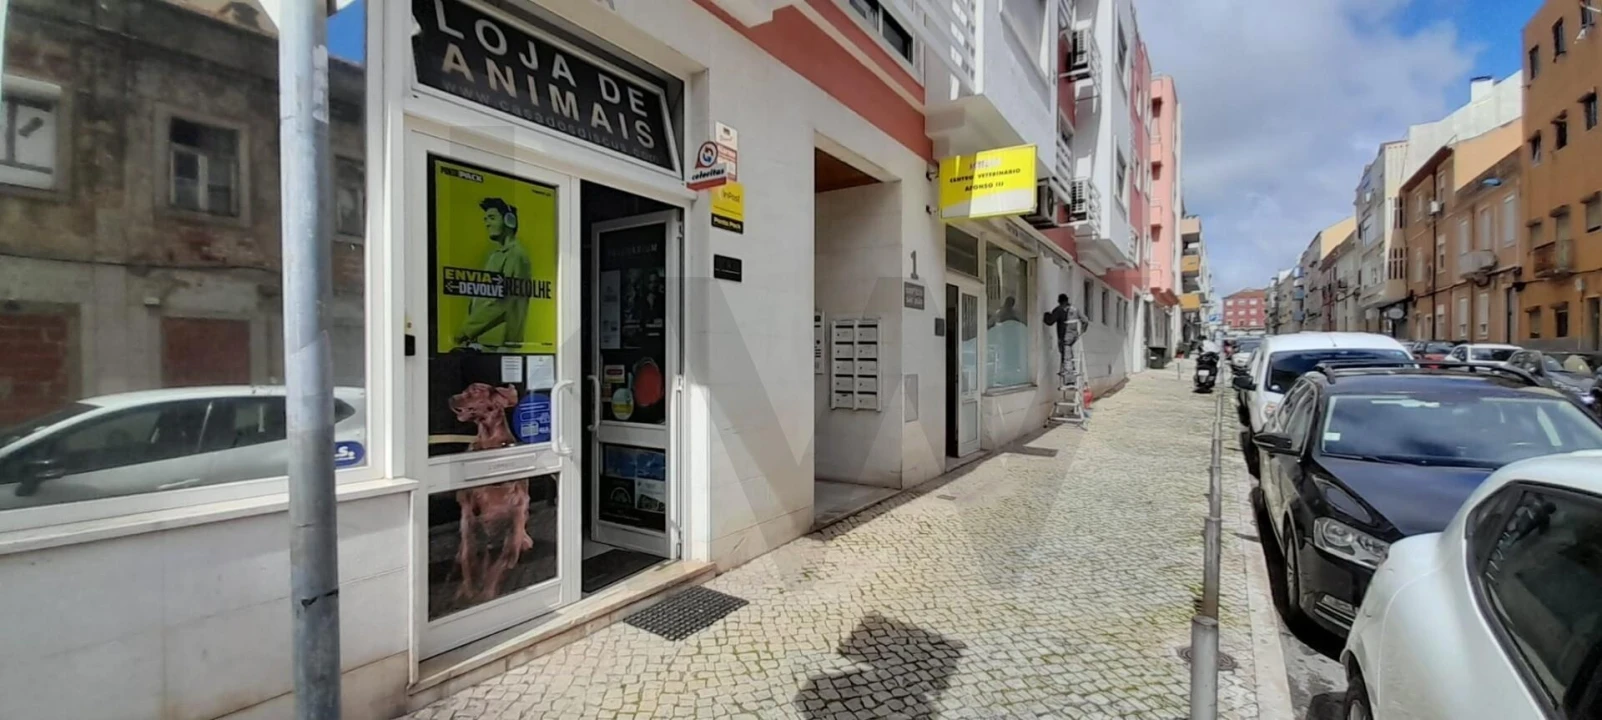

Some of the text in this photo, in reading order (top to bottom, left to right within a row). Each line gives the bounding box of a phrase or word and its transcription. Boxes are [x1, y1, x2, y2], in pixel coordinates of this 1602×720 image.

[434, 0, 648, 117] LOJA DE
[442, 43, 655, 149] ANIMAIS
[950, 175, 974, 183] CENTRO
[965, 183, 994, 192] AFONSO
[910, 250, 919, 280] 1
[445, 269, 493, 283] ENVIA
[459, 282, 504, 297] DEVOLVE
[504, 277, 552, 299] RECOLHE
